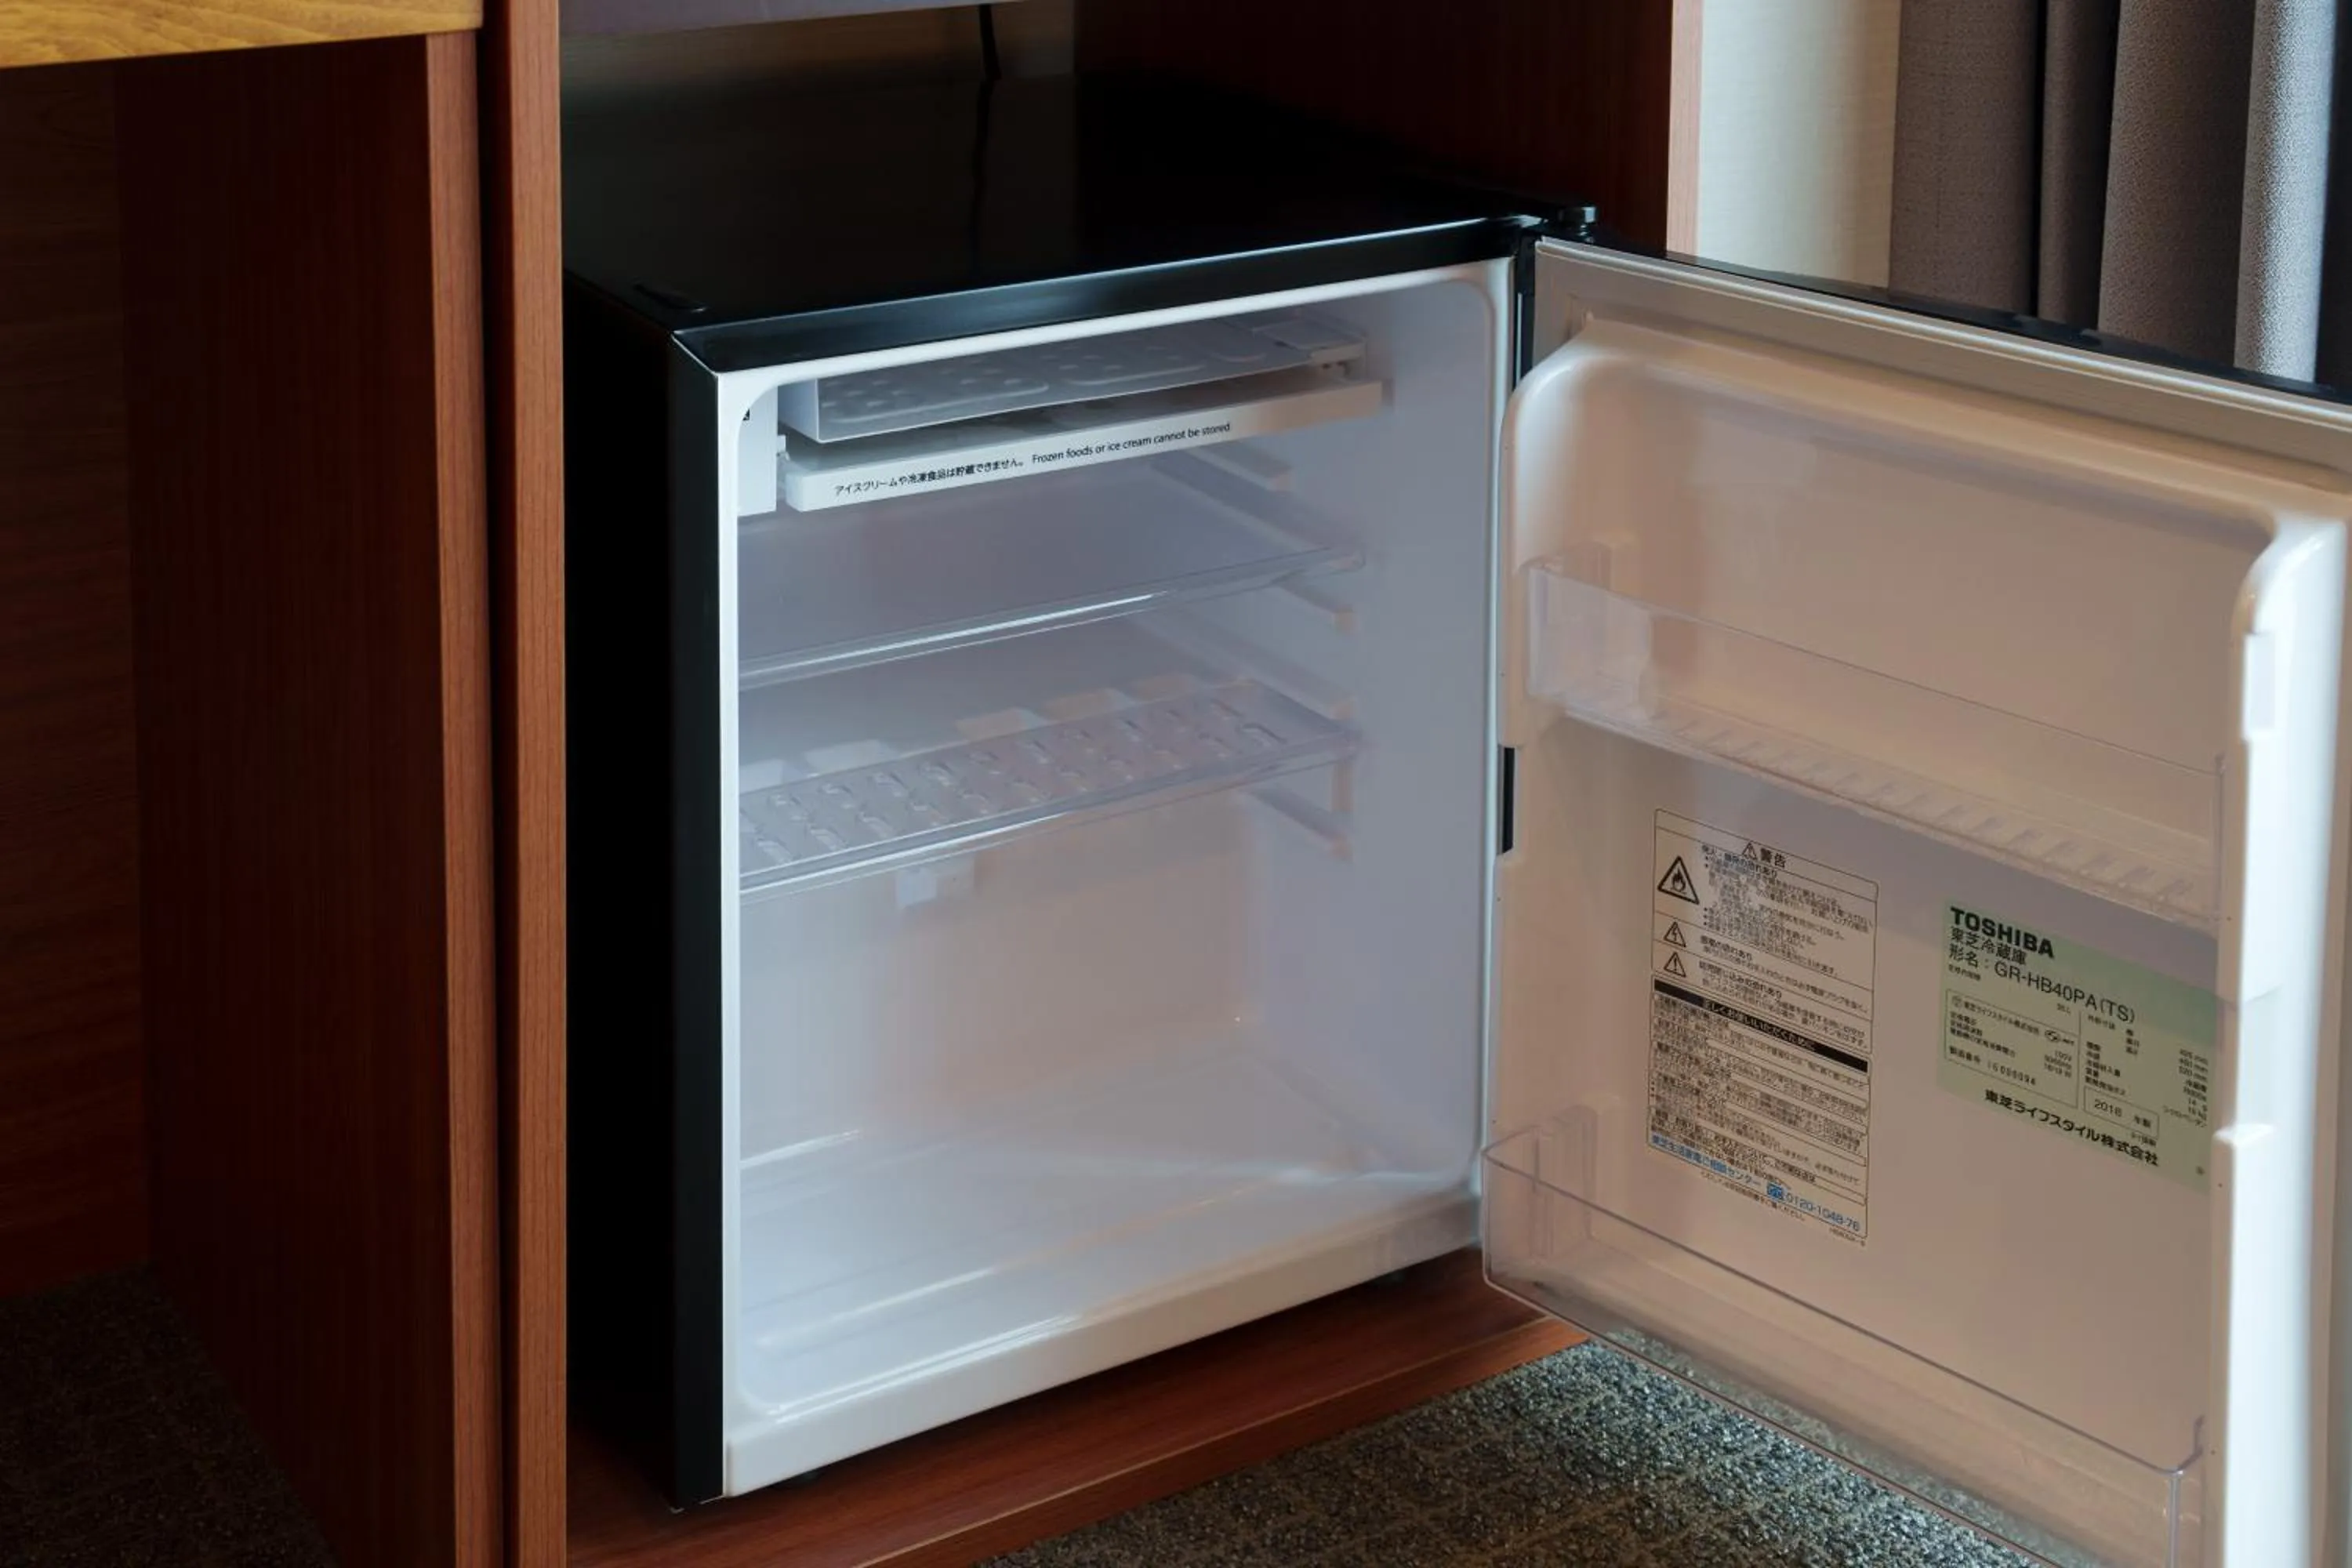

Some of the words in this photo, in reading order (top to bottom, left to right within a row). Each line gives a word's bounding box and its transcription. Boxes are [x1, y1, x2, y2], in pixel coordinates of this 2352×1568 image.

[1032, 451, 1064, 464] Frozen
[1065, 445, 1094, 459] foods
[1095, 444, 1105, 455] or
[1108, 441, 1121, 452] ice
[1123, 437, 1152, 449] cream
[1153, 431, 1185, 445] cannot
[1188, 428, 1199, 438] be
[1202, 422, 1231, 436] stored
[1760, 847, 1786, 869] 警告
[1950, 906, 2055, 960] TOSHIBA
[1951, 925, 2027, 966] 東芝冷蔵庫
[1994, 961, 2135, 1023] GR-HB40PA(TS)
[1984, 1088, 2159, 1167] 東芝ライフスタイル株式会社
